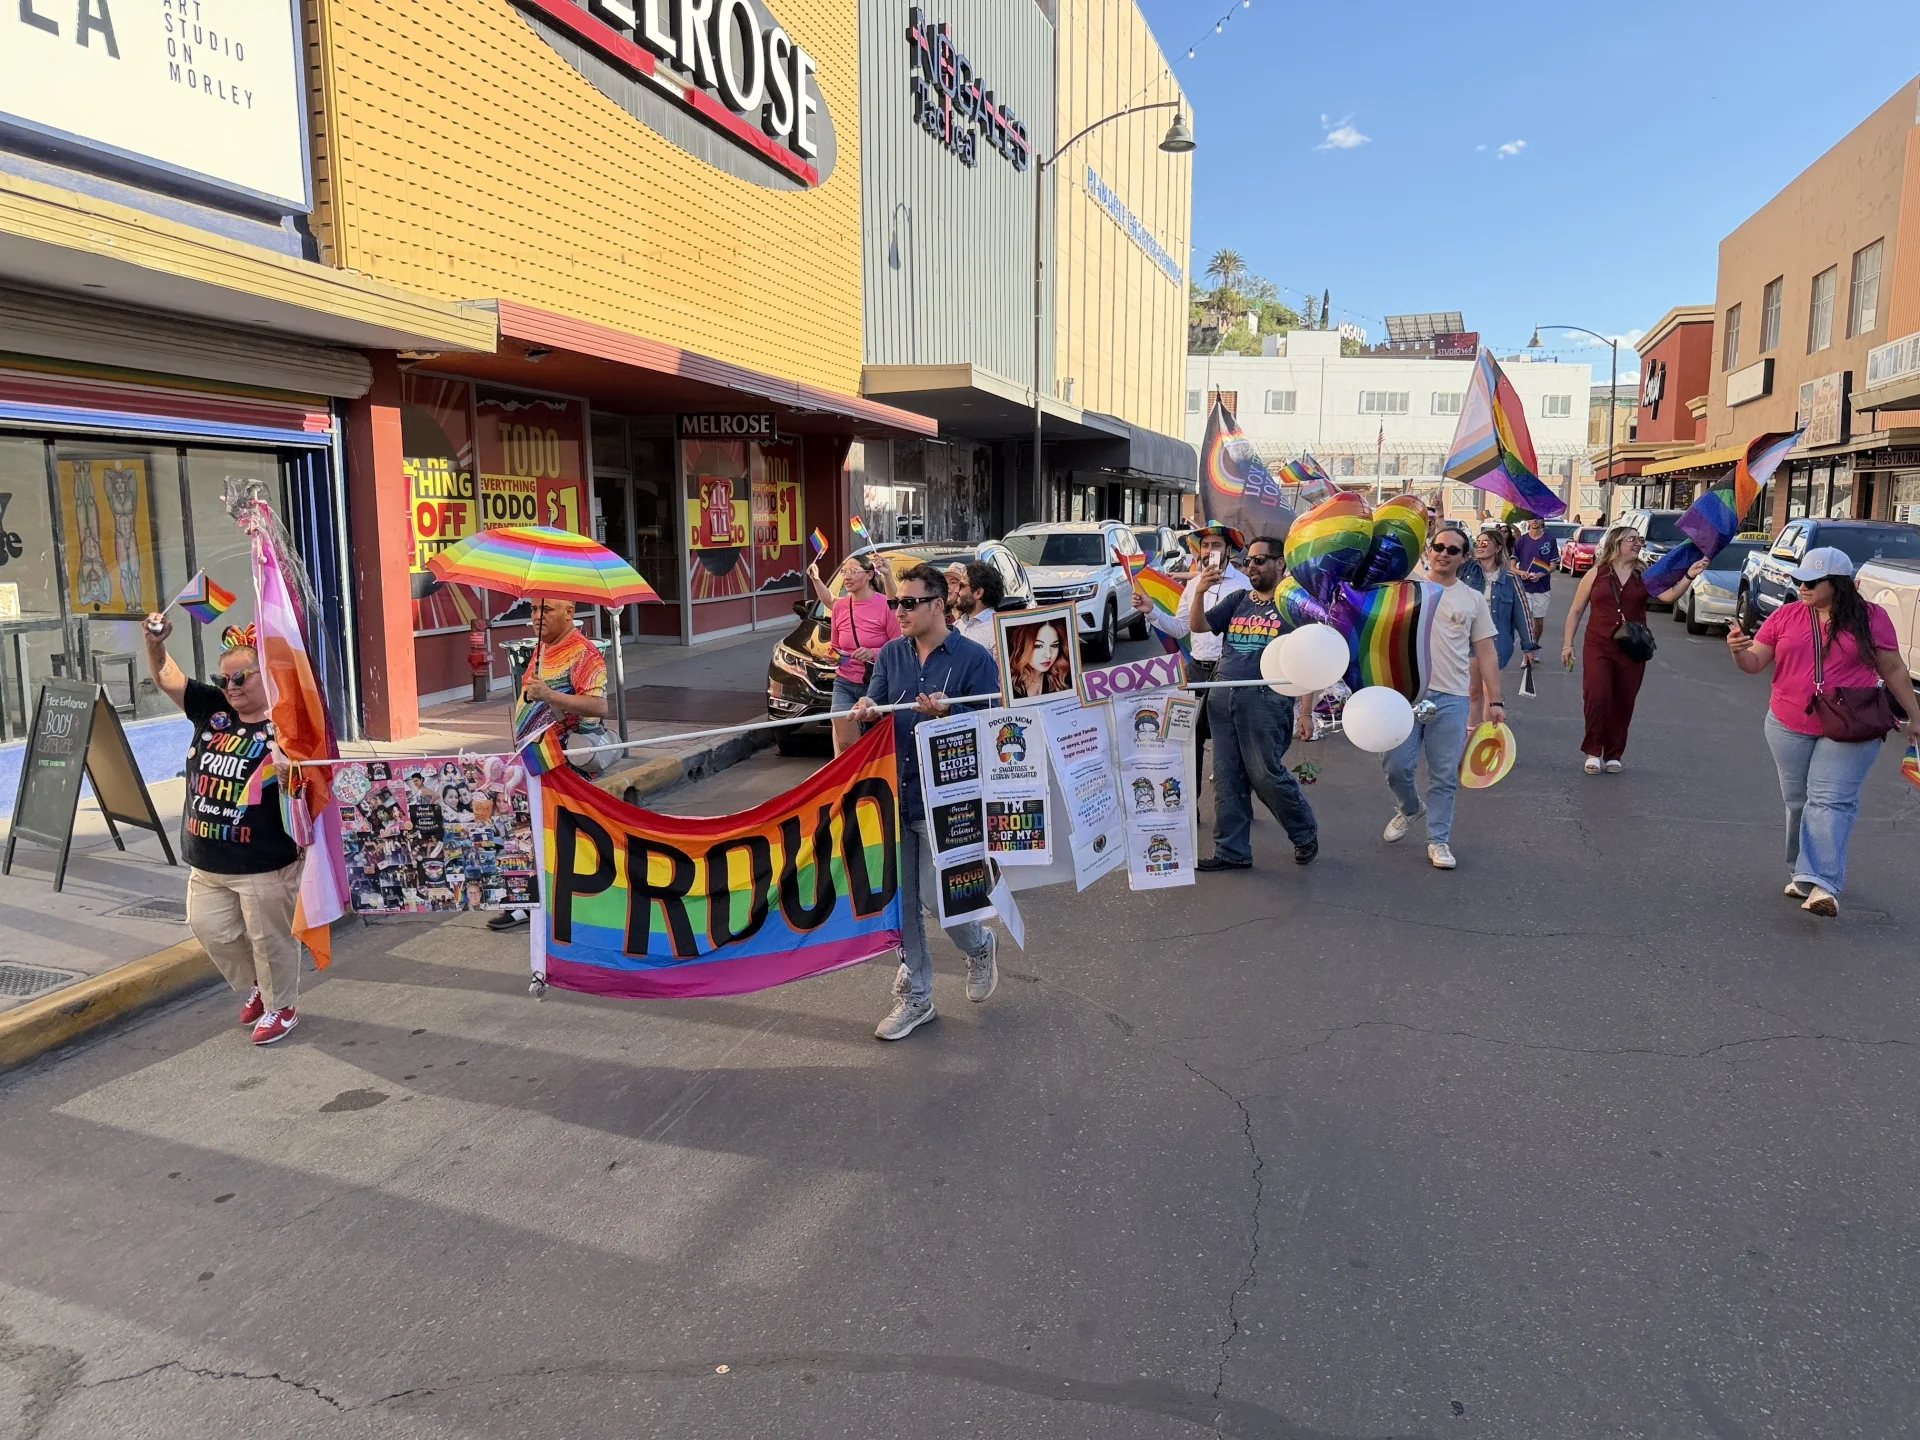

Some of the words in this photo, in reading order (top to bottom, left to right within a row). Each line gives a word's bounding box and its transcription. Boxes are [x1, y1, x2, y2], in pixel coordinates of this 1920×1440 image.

[164, 12, 244, 62] STUDIO
[167, 37, 193, 64] ON
[169, 61, 253, 109] MORLEY
[682, 414, 770, 434] MELROSE
[498, 422, 561, 479] TODO
[482, 493, 537, 520] TODO
[753, 493, 778, 512] TODO
[780, 485, 798, 541] $1
[416, 501, 468, 538] OFF
[753, 525, 778, 544] TODO
[1084, 653, 1180, 701] ROXY
[41, 709, 73, 738] BODY
[988, 716, 1013, 729] PROUD
[1014, 715, 1033, 726] MOM
[206, 731, 265, 759] PROUD
[946, 734, 964, 744] PROUD
[948, 740, 963, 748] YOU
[937, 743, 975, 761] FREE
[199, 752, 250, 780] PRIDE
[945, 756, 970, 770] MOM
[940, 765, 977, 783] HUGS
[1011, 771, 1038, 780] DAUGHTER
[189, 770, 244, 803] MOTHE
[198, 796, 221, 816] love
[222, 805, 245, 825] my
[1003, 800, 1024, 814] I'M
[986, 813, 1045, 831] PROUD
[1000, 831, 1014, 841] OF
[1016, 829, 1034, 840] MY
[988, 840, 1046, 852] DAUGHTER
[552, 776, 899, 960] PROUD
[948, 868, 984, 887] PROUD
[949, 878, 986, 901] MOM
